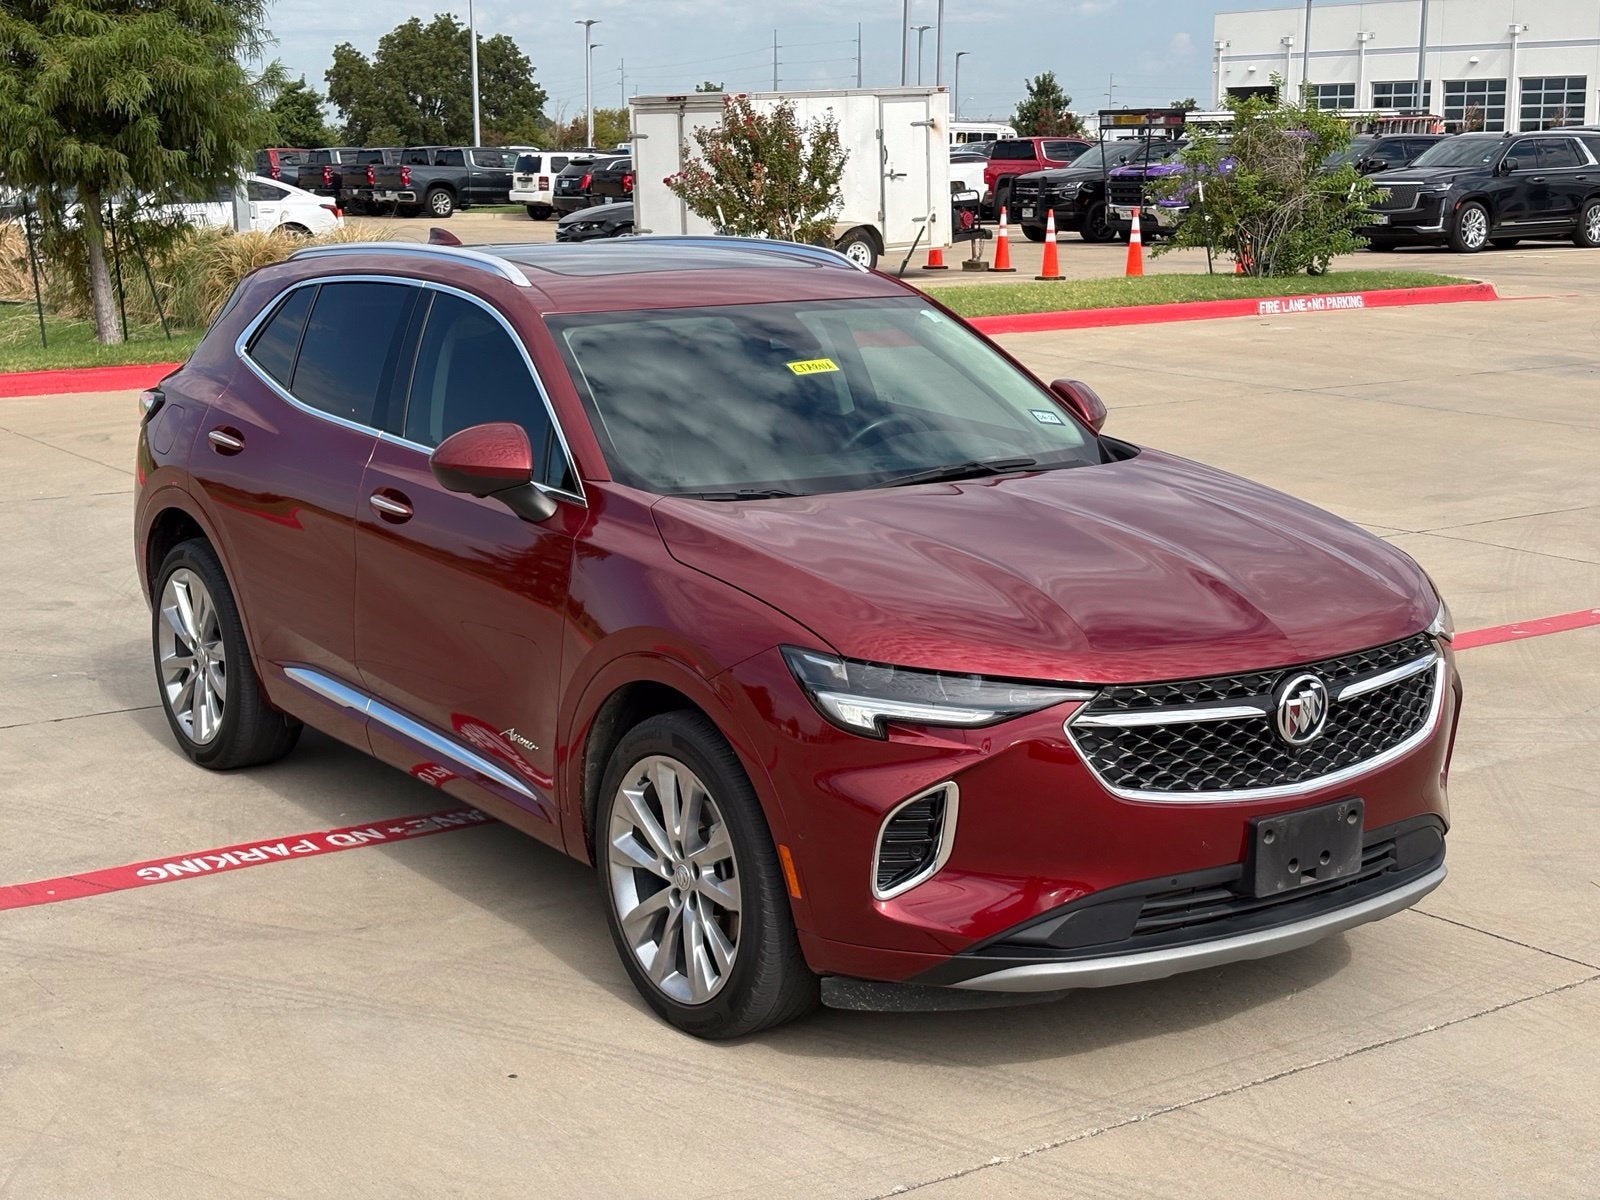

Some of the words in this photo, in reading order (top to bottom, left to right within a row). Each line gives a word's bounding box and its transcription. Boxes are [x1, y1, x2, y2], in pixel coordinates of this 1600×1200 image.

[1259, 300, 1281, 315] FIRE
[1282, 298, 1308, 312] LANE
[1311, 297, 1325, 310] NO
[1325, 295, 1364, 309] PARKING
[325, 827, 390, 847] NO
[136, 839, 321, 881] PARKING
